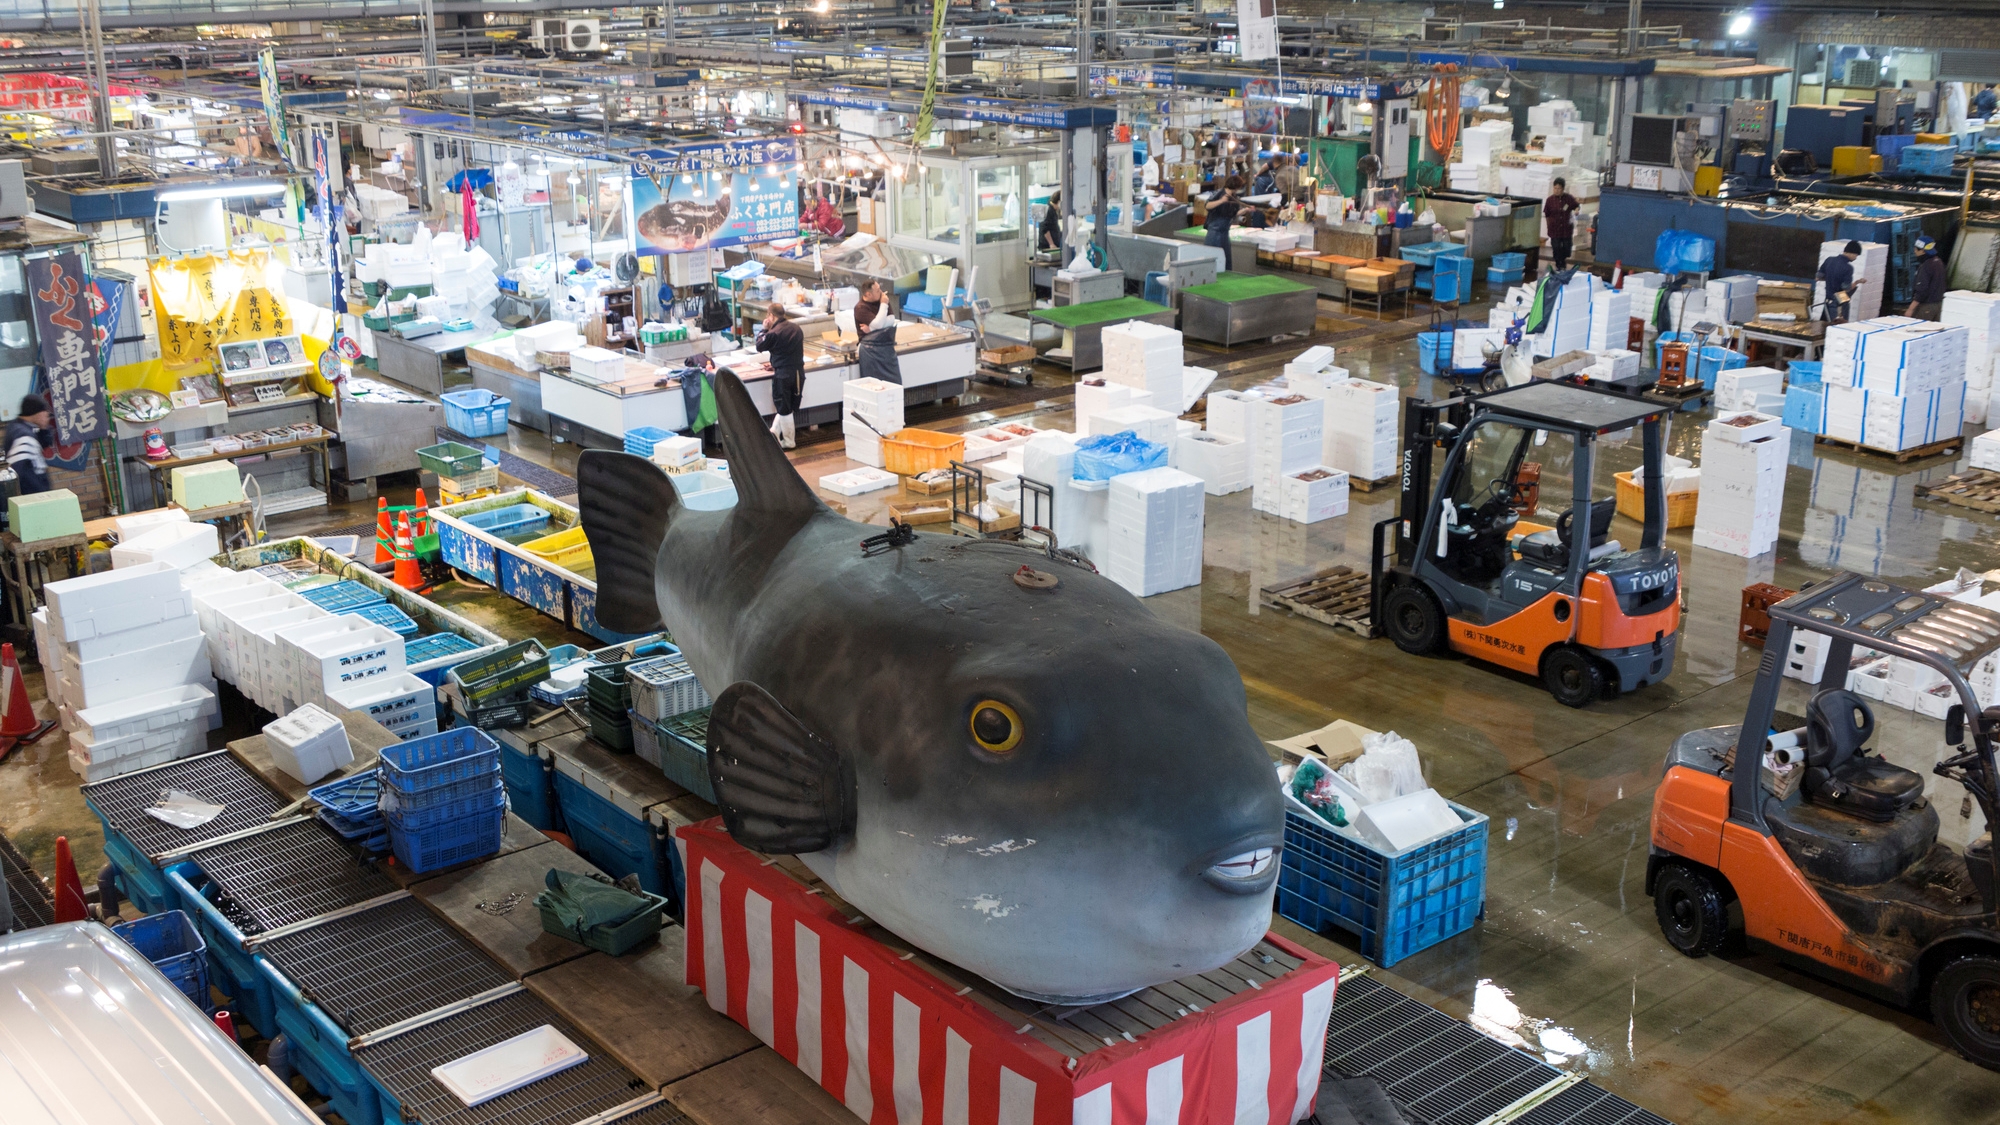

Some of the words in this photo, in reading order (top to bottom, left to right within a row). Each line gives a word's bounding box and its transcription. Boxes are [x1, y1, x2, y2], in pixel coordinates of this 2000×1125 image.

[730, 199, 795, 220] ふく専門店
[38, 262, 99, 434] ふく専門店
[1403, 449, 1412, 492] TOYOTA
[1515, 579, 1533, 592] 15
[1630, 563, 1678, 590] TOYOTA
